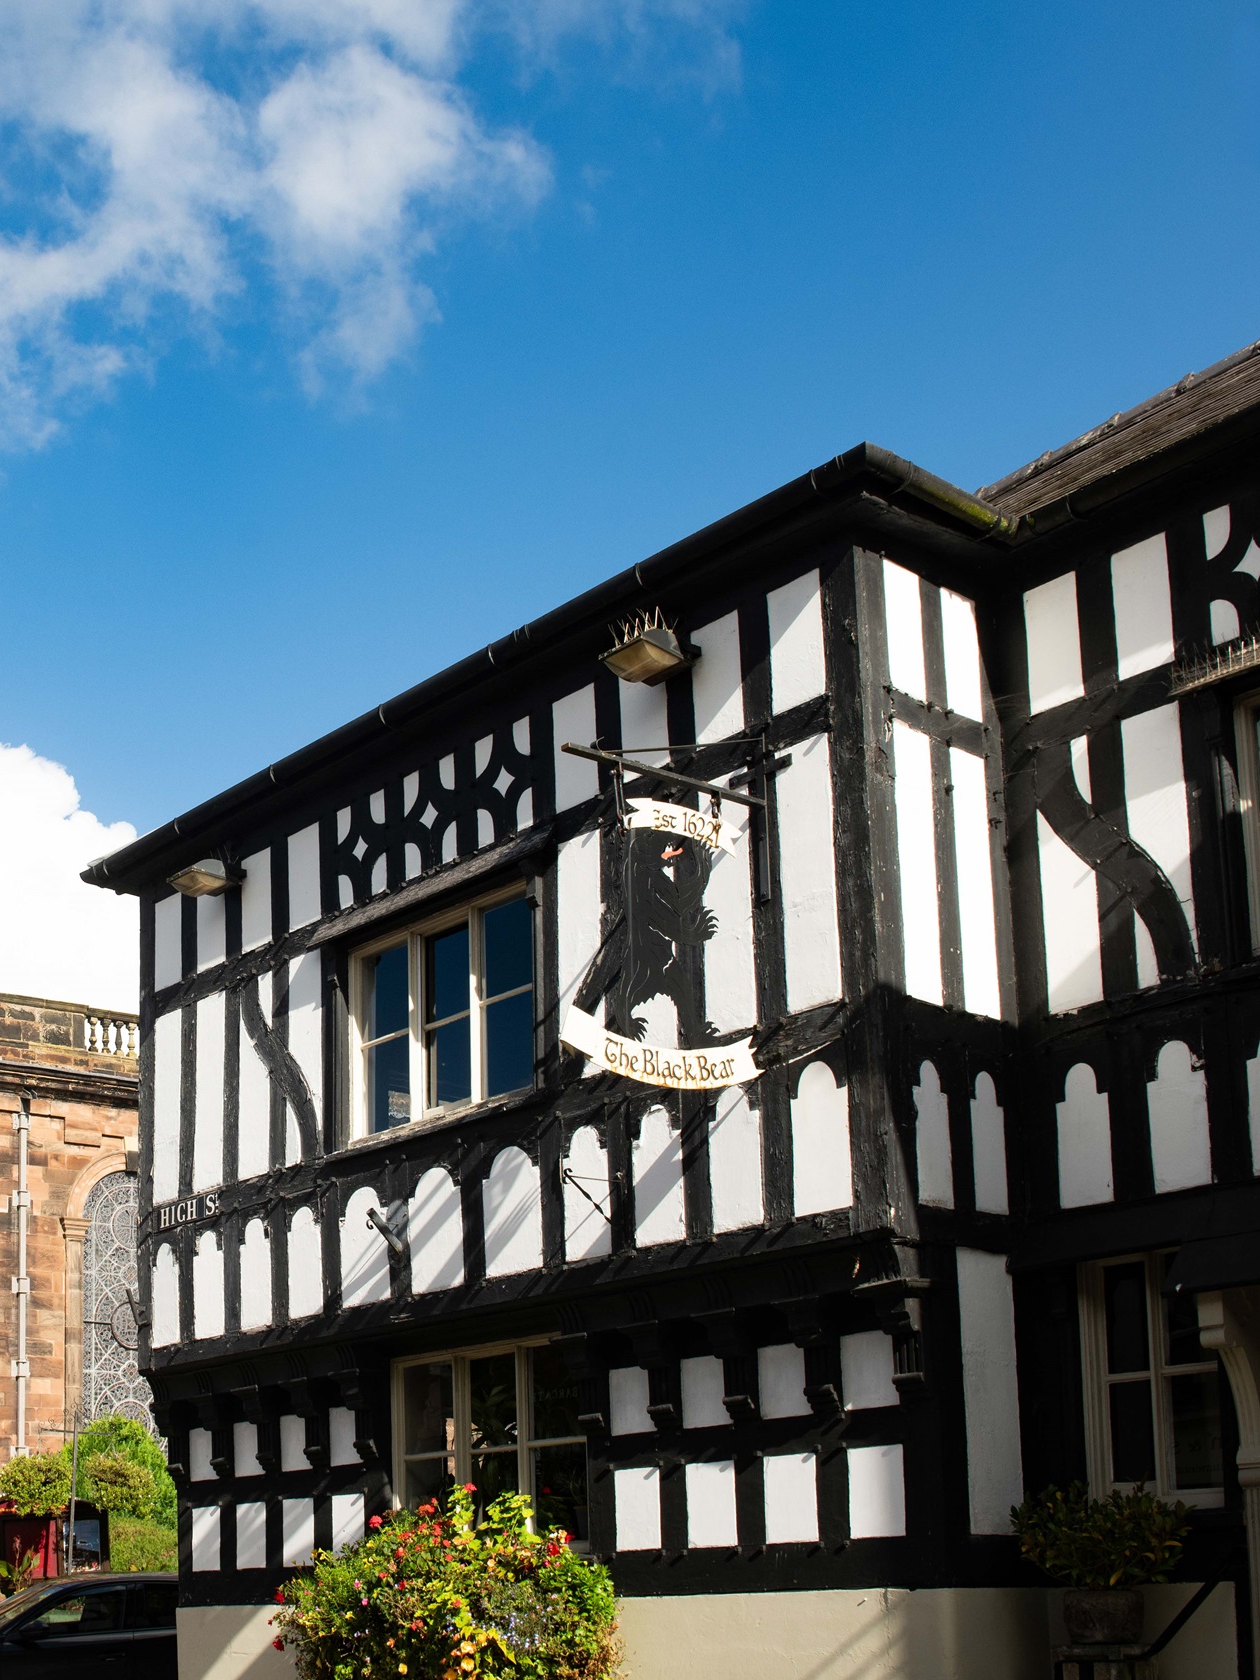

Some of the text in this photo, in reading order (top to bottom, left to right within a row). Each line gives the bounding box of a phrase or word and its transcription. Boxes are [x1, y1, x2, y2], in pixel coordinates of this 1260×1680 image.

[604, 1036, 735, 1082] The Black Bear
[160, 1199, 198, 1229] HIGH
